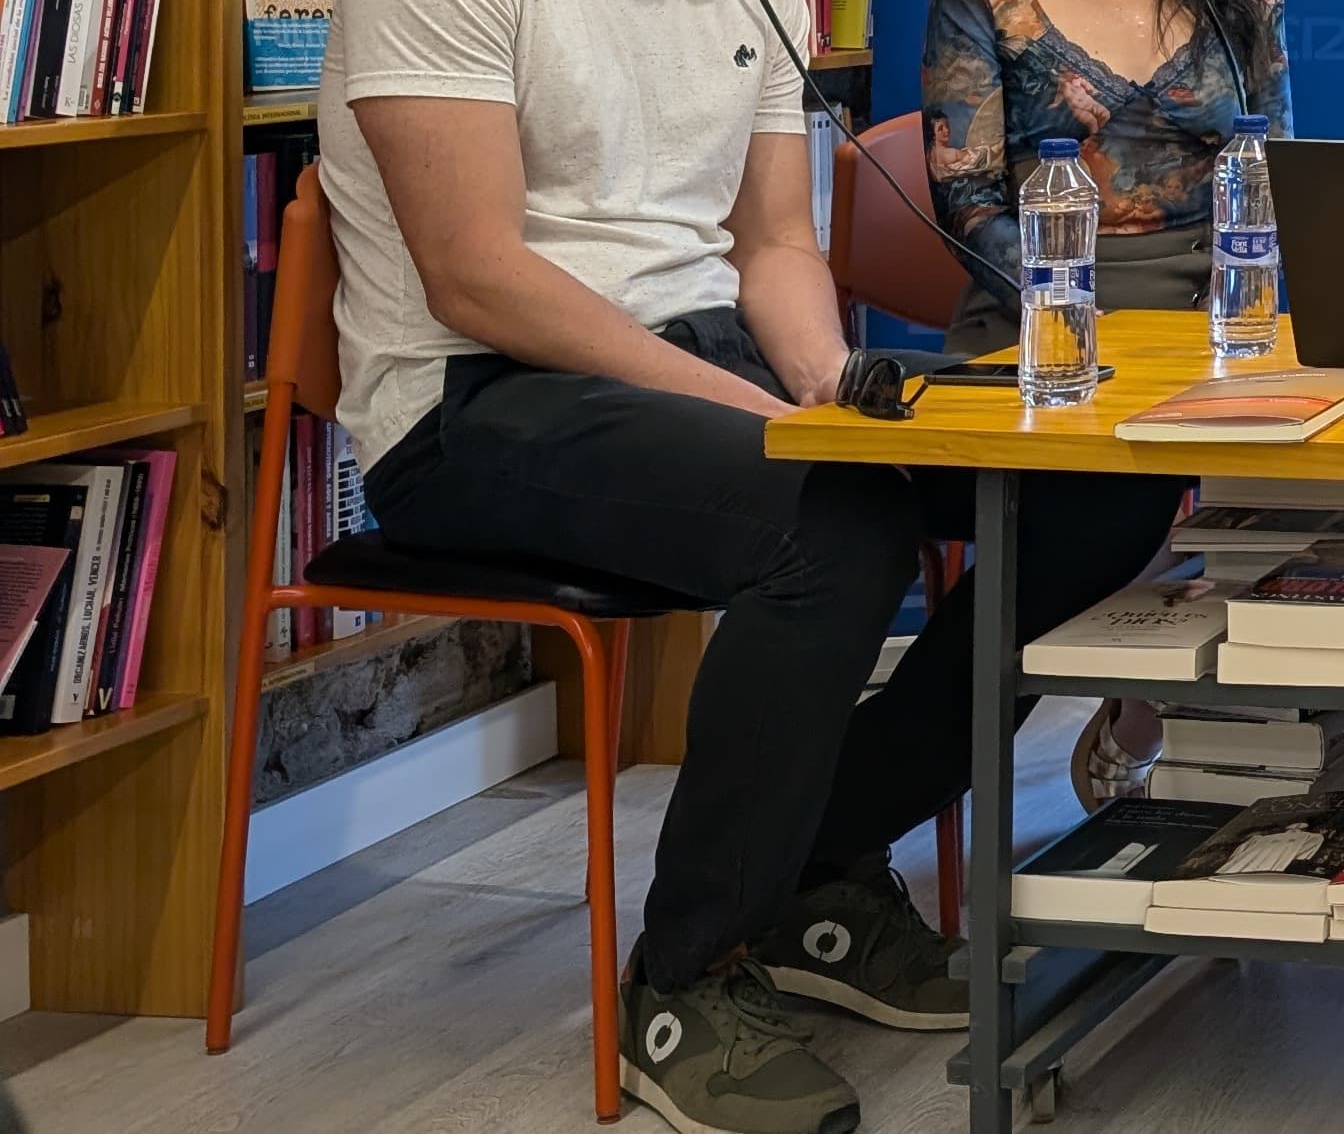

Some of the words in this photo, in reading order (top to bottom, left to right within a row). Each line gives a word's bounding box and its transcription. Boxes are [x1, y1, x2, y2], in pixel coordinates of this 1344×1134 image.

[69, 2, 84, 42] DIOSAS
[67, 45, 78, 64] LAS
[1231, 239, 1249, 247] Font
